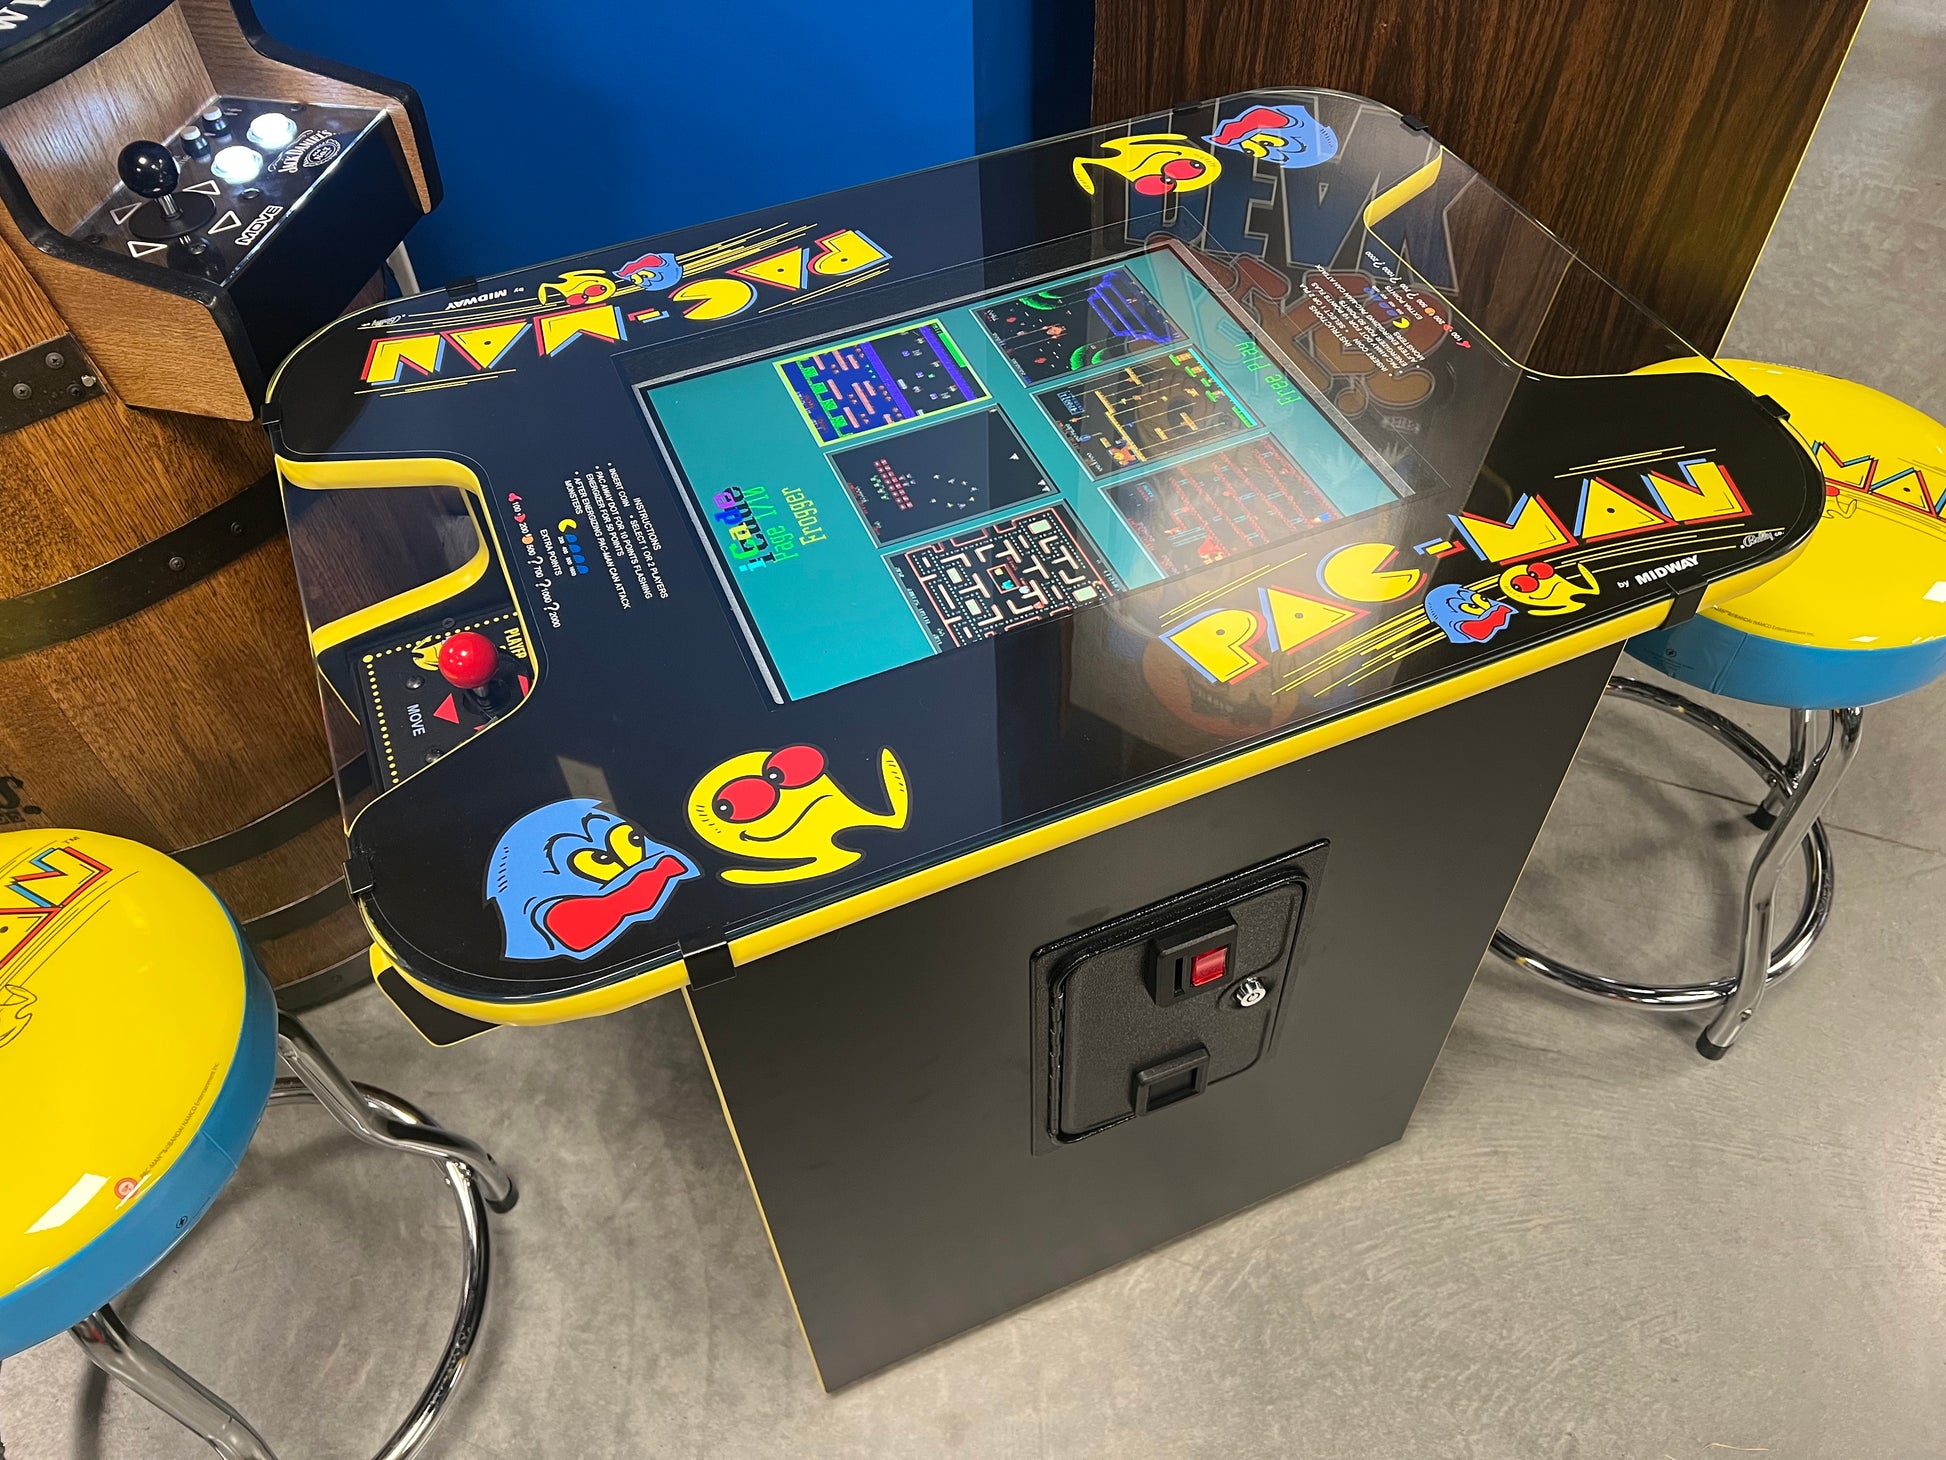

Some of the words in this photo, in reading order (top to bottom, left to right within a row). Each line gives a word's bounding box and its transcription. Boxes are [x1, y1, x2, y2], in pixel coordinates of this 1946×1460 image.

[235, 205, 284, 246] MOVE
[445, 289, 508, 311] MIDWAY
[1384, 285, 1406, 304] POINTS
[1309, 305, 1352, 347] INSTRUCTIONS
[1404, 303, 1423, 320] EXTRA
[1233, 341, 1272, 372] Play
[1352, 338, 1369, 352] COIN
[1393, 331, 1425, 361] MONSTERS
[1366, 352, 1388, 372] INSERT
[1265, 373, 1303, 406] Free
[574, 478, 587, 498] AFTER
[586, 473, 605, 509] ENERGIZER
[595, 471, 606, 483] PAC
[600, 482, 613, 501] AWAY
[609, 468, 624, 490] INSERT
[618, 491, 630, 507] COIN
[564, 480, 583, 515] MONSTERS
[608, 500, 619, 515] DOT
[741, 486, 777, 519] 1/10
[582, 498, 602, 537] ENERGIZING
[600, 509, 611, 523] FOR
[606, 523, 614, 531] 50
[613, 516, 625, 531] FOR
[633, 497, 661, 550] INSTRUCTIONS
[781, 486, 827, 546] Frogger
[609, 532, 624, 556] POINTS
[620, 531, 628, 539] 10
[766, 525, 799, 563] Page
[512, 501, 521, 512] 100
[519, 522, 529, 534] 200
[526, 544, 536, 556] 500
[534, 565, 544, 578] 700
[541, 586, 552, 603] 1000
[549, 609, 561, 628] 2000
[540, 529, 553, 551] EXTRA
[548, 551, 562, 576] POINTS
[597, 537, 615, 567] PAC-MAN
[623, 539, 639, 564] POINTS
[630, 520, 646, 544] SELECT
[643, 551, 653, 562] OR
[650, 567, 668, 598] PLAYERS
[609, 567, 620, 582] CAN
[633, 565, 653, 599] FLASHING
[1616, 579, 1630, 589] by
[1634, 554, 1699, 585] MIDWAY
[614, 583, 631, 609] ATTACK
[406, 703, 426, 737] MOVE
[182, 1106, 198, 1127] NAMCO
[194, 1070, 216, 1107] Entertainment
